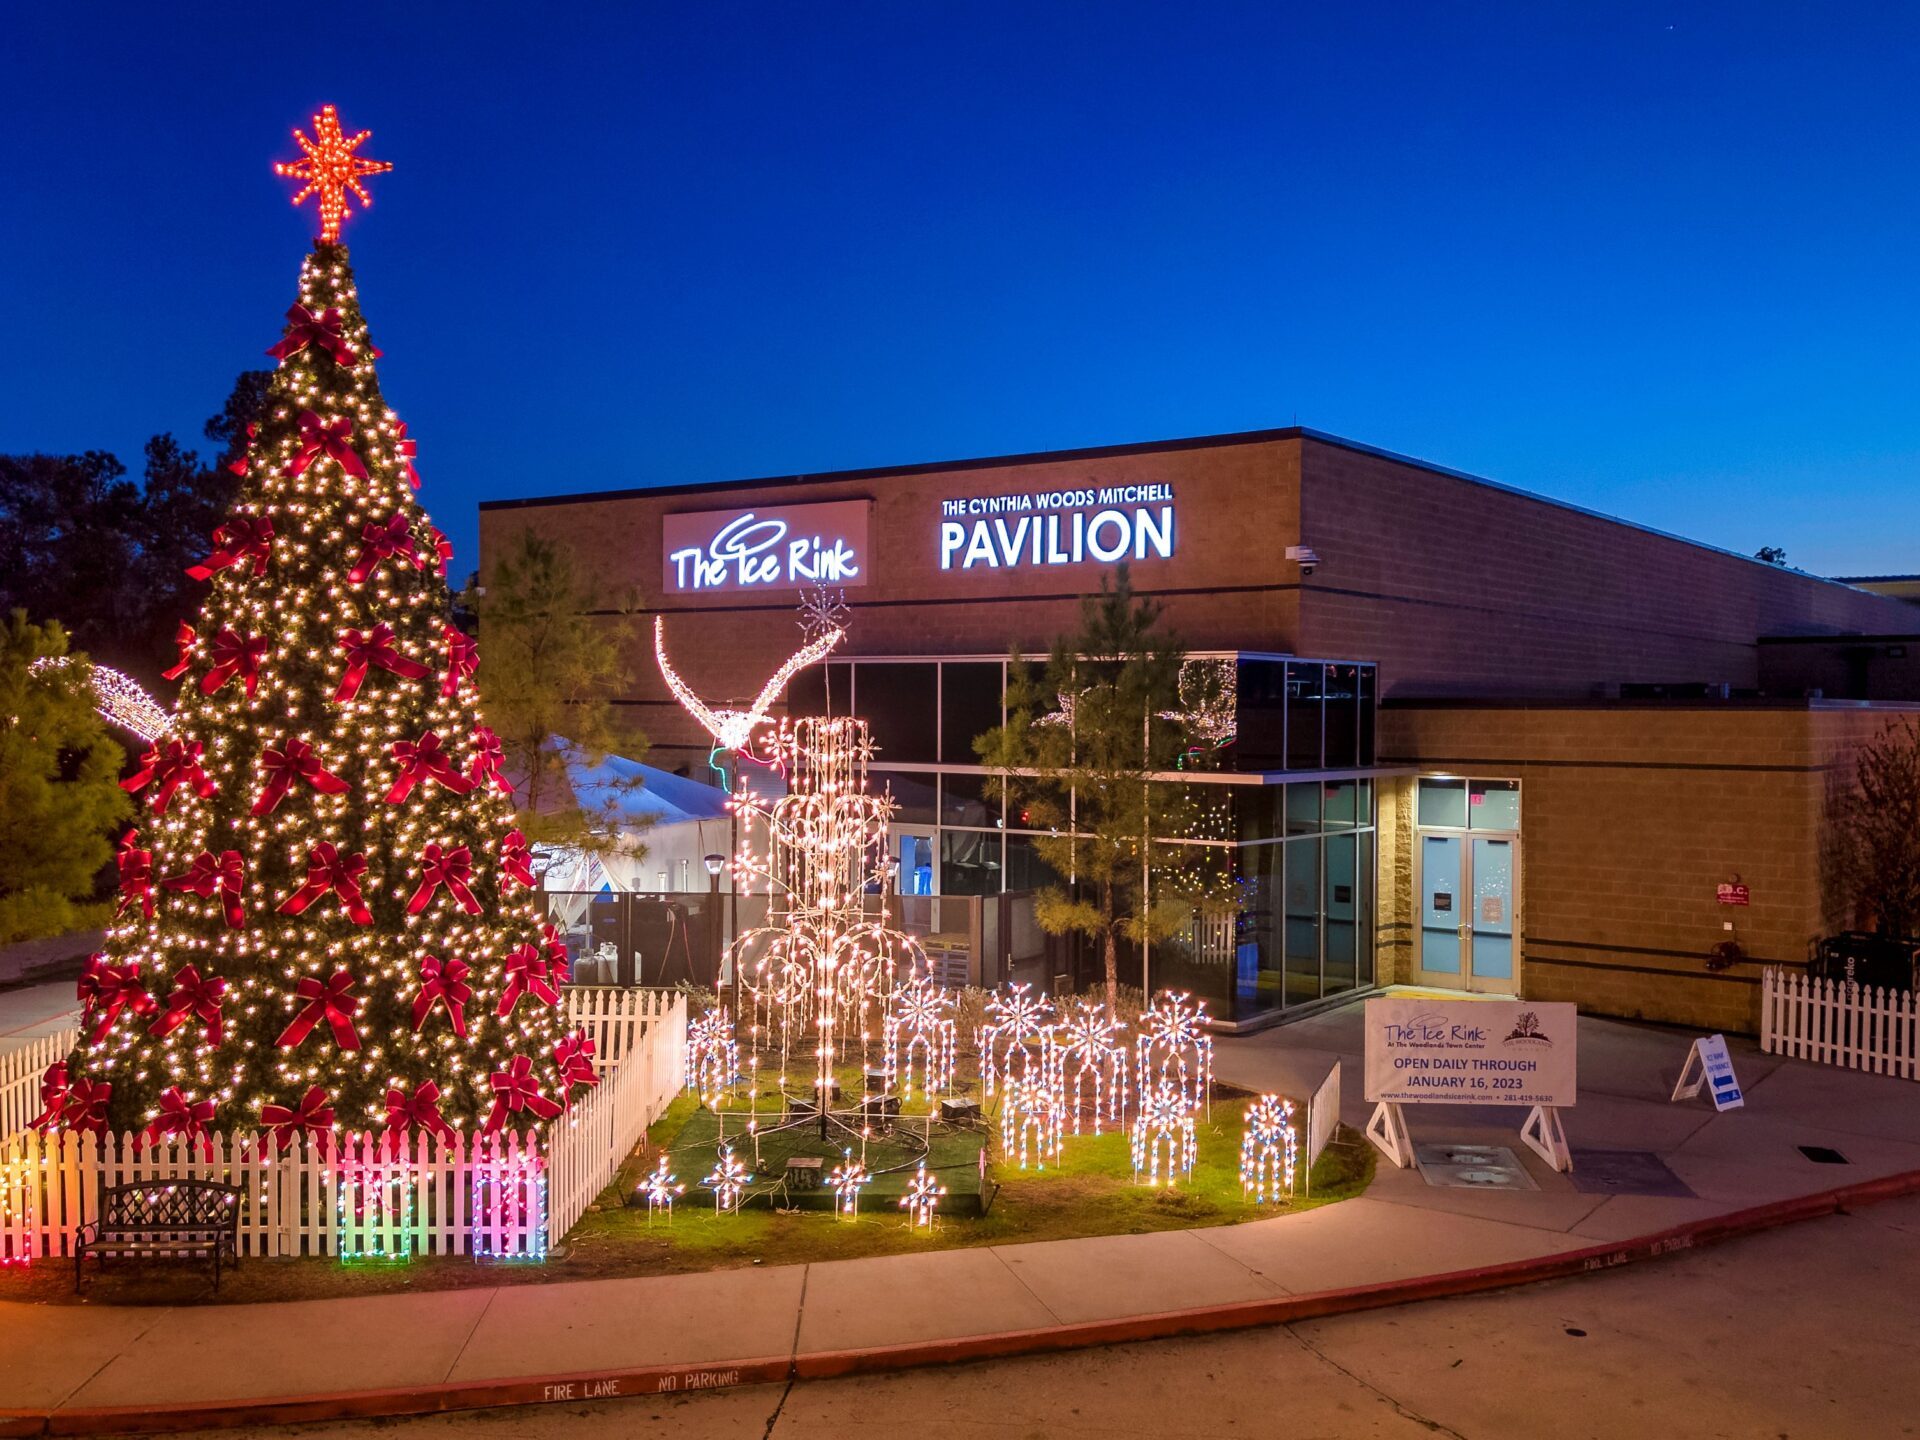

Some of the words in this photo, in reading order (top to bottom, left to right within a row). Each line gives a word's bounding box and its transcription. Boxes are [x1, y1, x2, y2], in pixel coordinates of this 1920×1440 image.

[942, 500, 966, 516] THE
[969, 495, 1032, 514] CYNTHIA
[1036, 489, 1094, 509] WOODS
[1098, 484, 1172, 504] MITCHELL
[941, 506, 1173, 570] PAVILION
[670, 548, 727, 589] The
[736, 543, 780, 585] Ice
[789, 536, 859, 582] Rink
[1384, 1025, 1416, 1040] The
[1423, 1025, 1445, 1040] Ice
[1451, 1025, 1487, 1041] Rink
[1394, 1058, 1429, 1070] OPEN
[1433, 1059, 1468, 1070] DAILY
[1472, 1060, 1537, 1071] THROUGH
[1407, 1076, 1466, 1088] JANUARY
[1470, 1077, 1488, 1090] 16,
[1492, 1078, 1523, 1089] 2023
[1380, 1092, 1493, 1101] www.thewoodlandsicerink.com
[544, 1384, 575, 1400] FIRE
[584, 1380, 620, 1397] LANE
[659, 1376, 677, 1393] NO
[685, 1370, 739, 1390] PARKING
